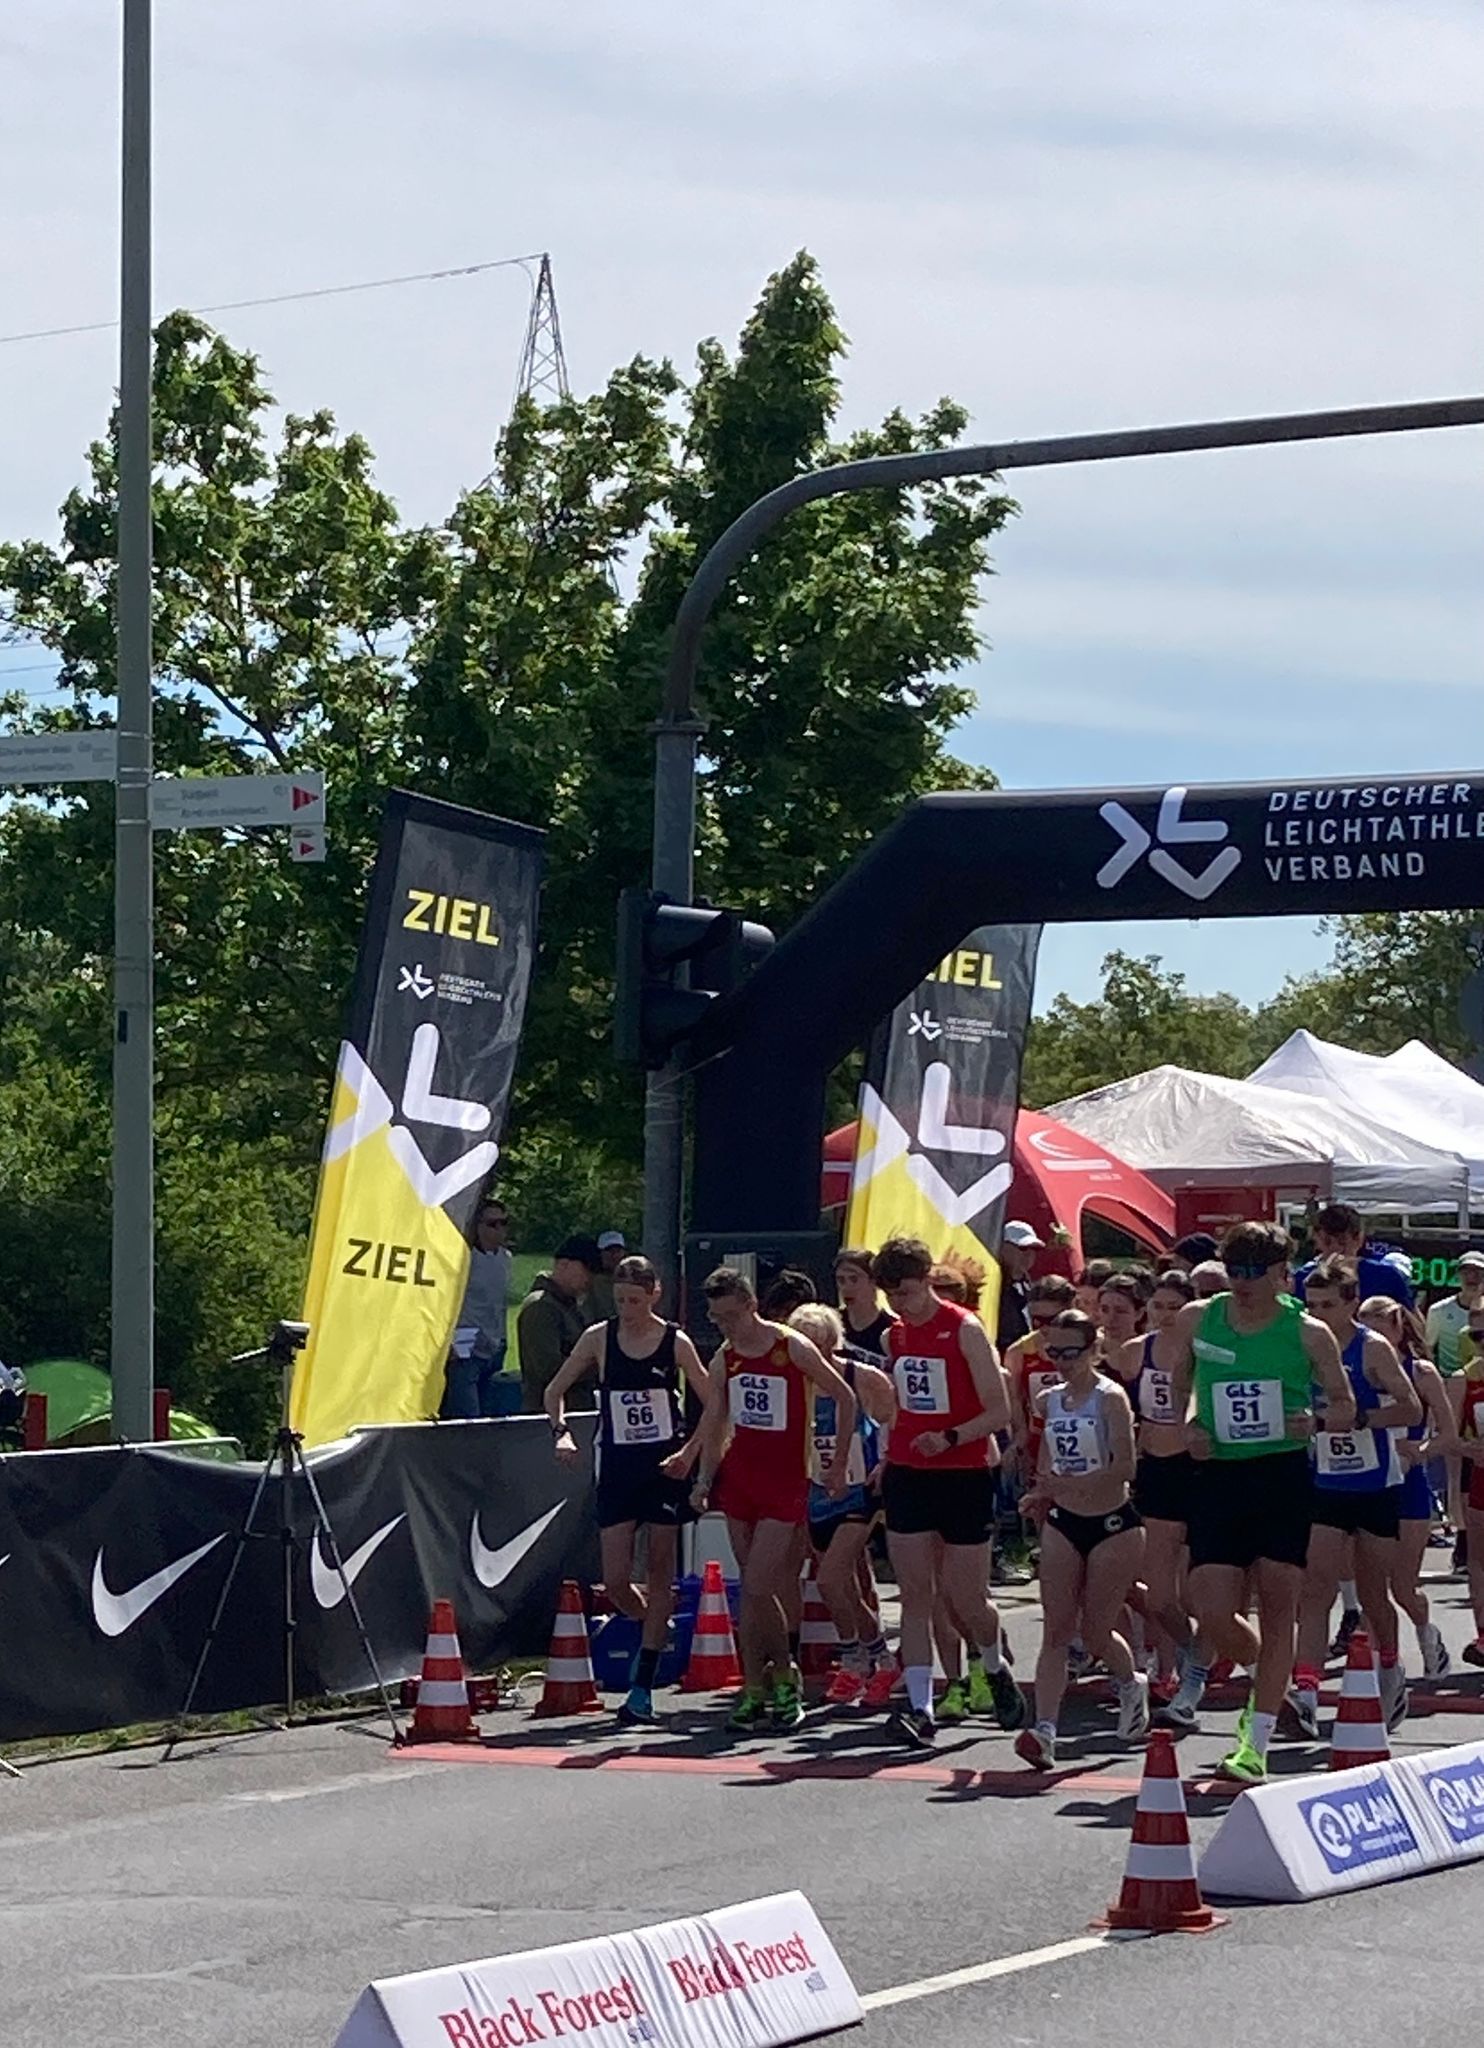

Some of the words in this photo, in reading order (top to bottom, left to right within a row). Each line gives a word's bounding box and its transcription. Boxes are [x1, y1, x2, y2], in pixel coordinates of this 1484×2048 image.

[1268, 783, 1471, 812] DEUTSCHER
[1264, 852, 1425, 881] VERBAND
[402, 889, 500, 946] ZIEL
[925, 950, 1003, 989] IEL
[342, 1238, 436, 1287] ZIEL
[903, 1358, 929, 1373] GLS
[740, 1376, 769, 1390] GLS
[906, 1374, 930, 1396] 64
[1151, 1373, 1169, 1386] GL
[621, 1390, 651, 1406] GLS
[744, 1390, 769, 1412] 68
[1155, 1388, 1169, 1406] 5
[1226, 1383, 1262, 1399] GLS
[627, 1406, 654, 1426] 66
[1232, 1401, 1260, 1423] 51
[1052, 1419, 1079, 1434] GLS
[1056, 1435, 1080, 1457] 62
[1330, 1436, 1356, 1456] 65
[1342, 1793, 1403, 1835] PLAN
[732, 1931, 817, 1984] Forest
[438, 1997, 547, 2048] Black
[536, 1975, 645, 2037] Forest
